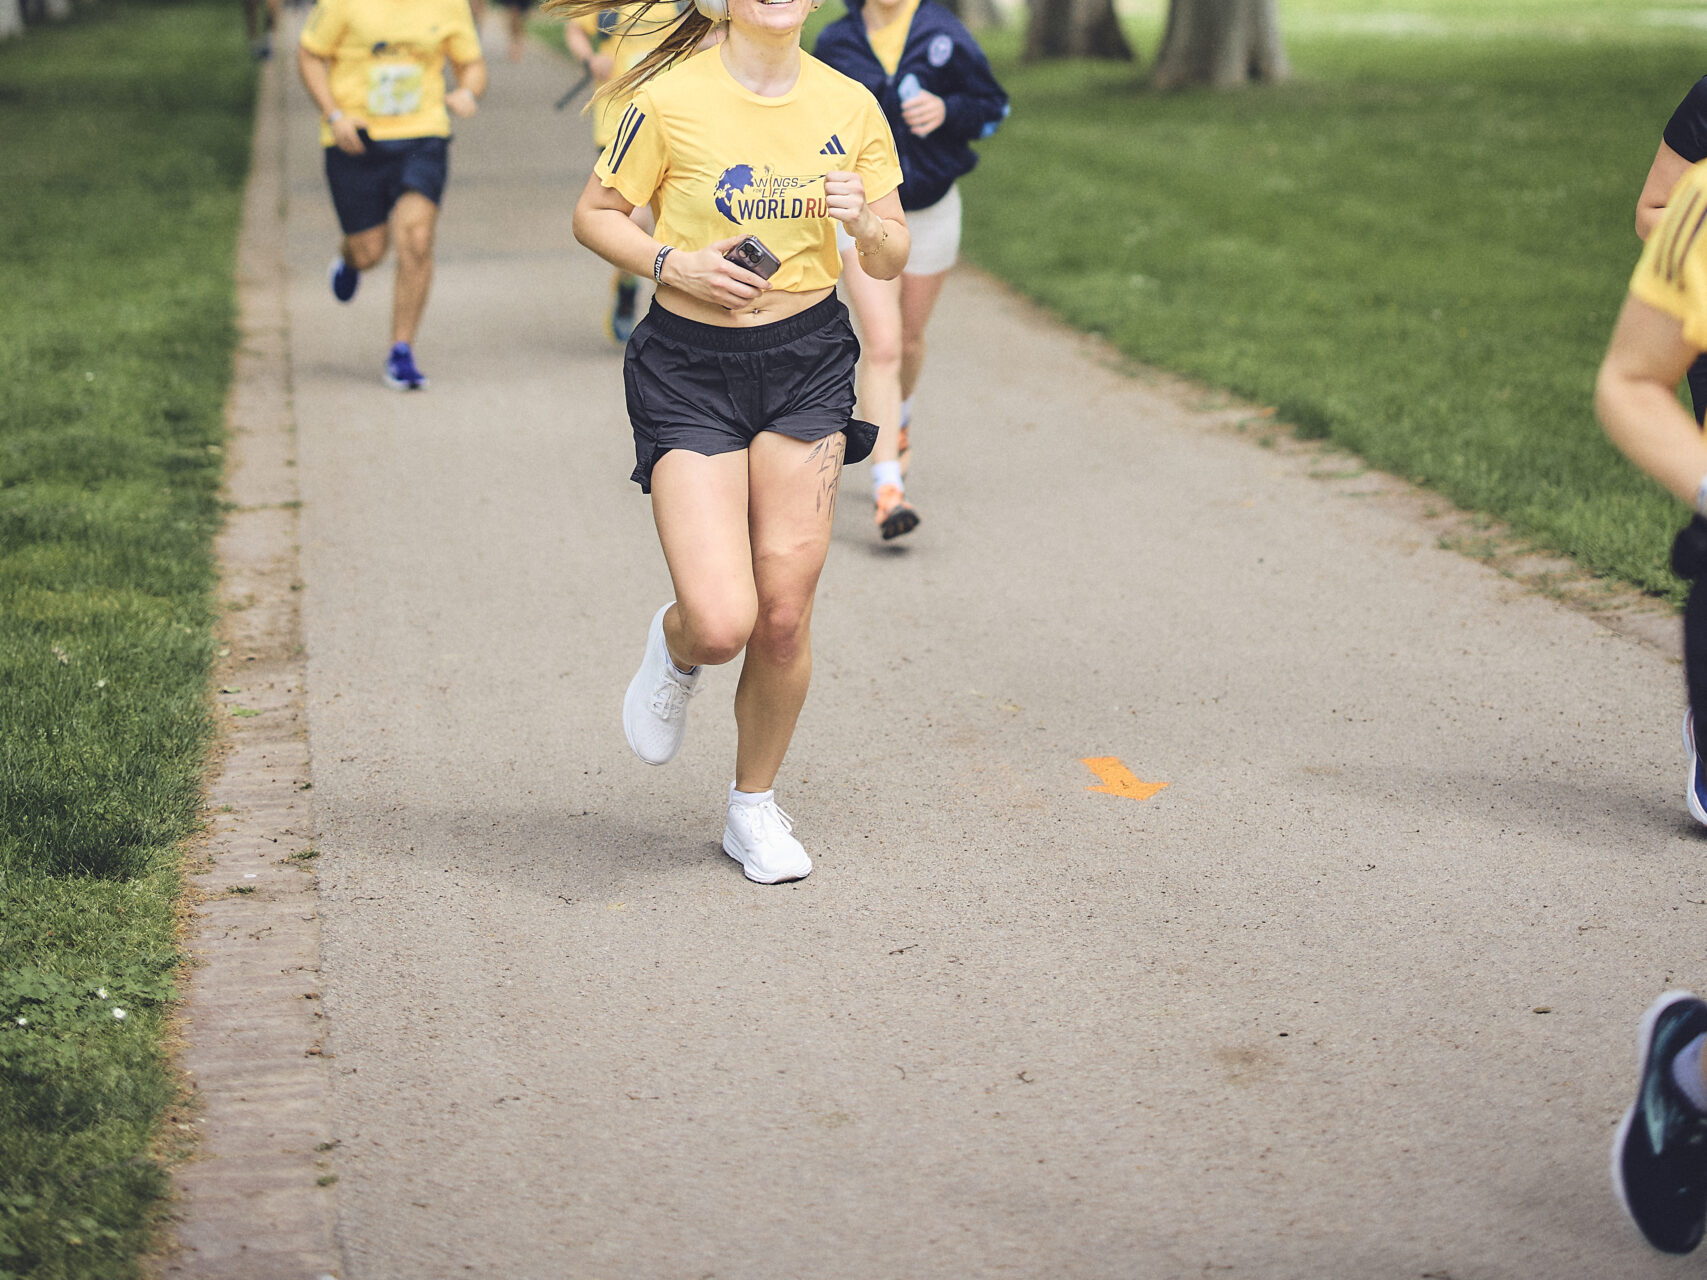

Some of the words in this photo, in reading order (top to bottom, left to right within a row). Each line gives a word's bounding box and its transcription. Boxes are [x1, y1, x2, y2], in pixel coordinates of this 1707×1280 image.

[754, 176, 799, 188] WINGS
[762, 187, 788, 198] LIFE
[738, 197, 803, 220] WORLD
[805, 197, 831, 219] RU
